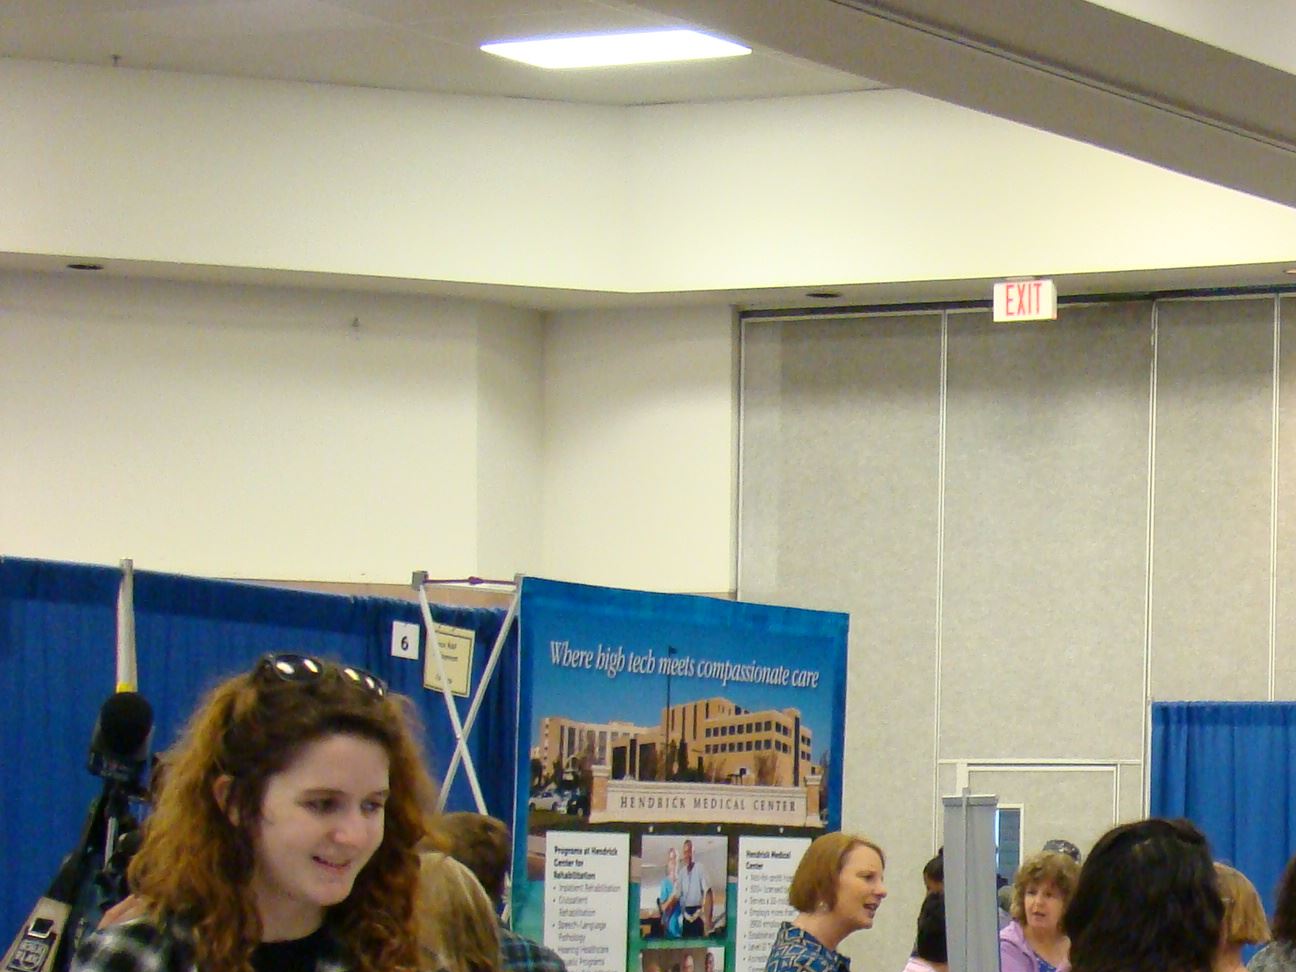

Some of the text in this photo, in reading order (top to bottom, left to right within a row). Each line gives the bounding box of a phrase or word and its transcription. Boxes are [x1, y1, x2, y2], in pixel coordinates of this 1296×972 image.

[1005, 283, 1043, 317] EXIT
[401, 635, 409, 651] 6
[549, 640, 820, 688] Where high tech meets compassionate care
[620, 796, 796, 812] HENDRICK MEDICAL CENTER
[554, 845, 618, 857] Programs at Hendrick
[745, 850, 791, 859] Hendrick Medical
[554, 858, 584, 868] Center for
[745, 861, 764, 870] Center
[553, 870, 596, 880] Rehabilitation
